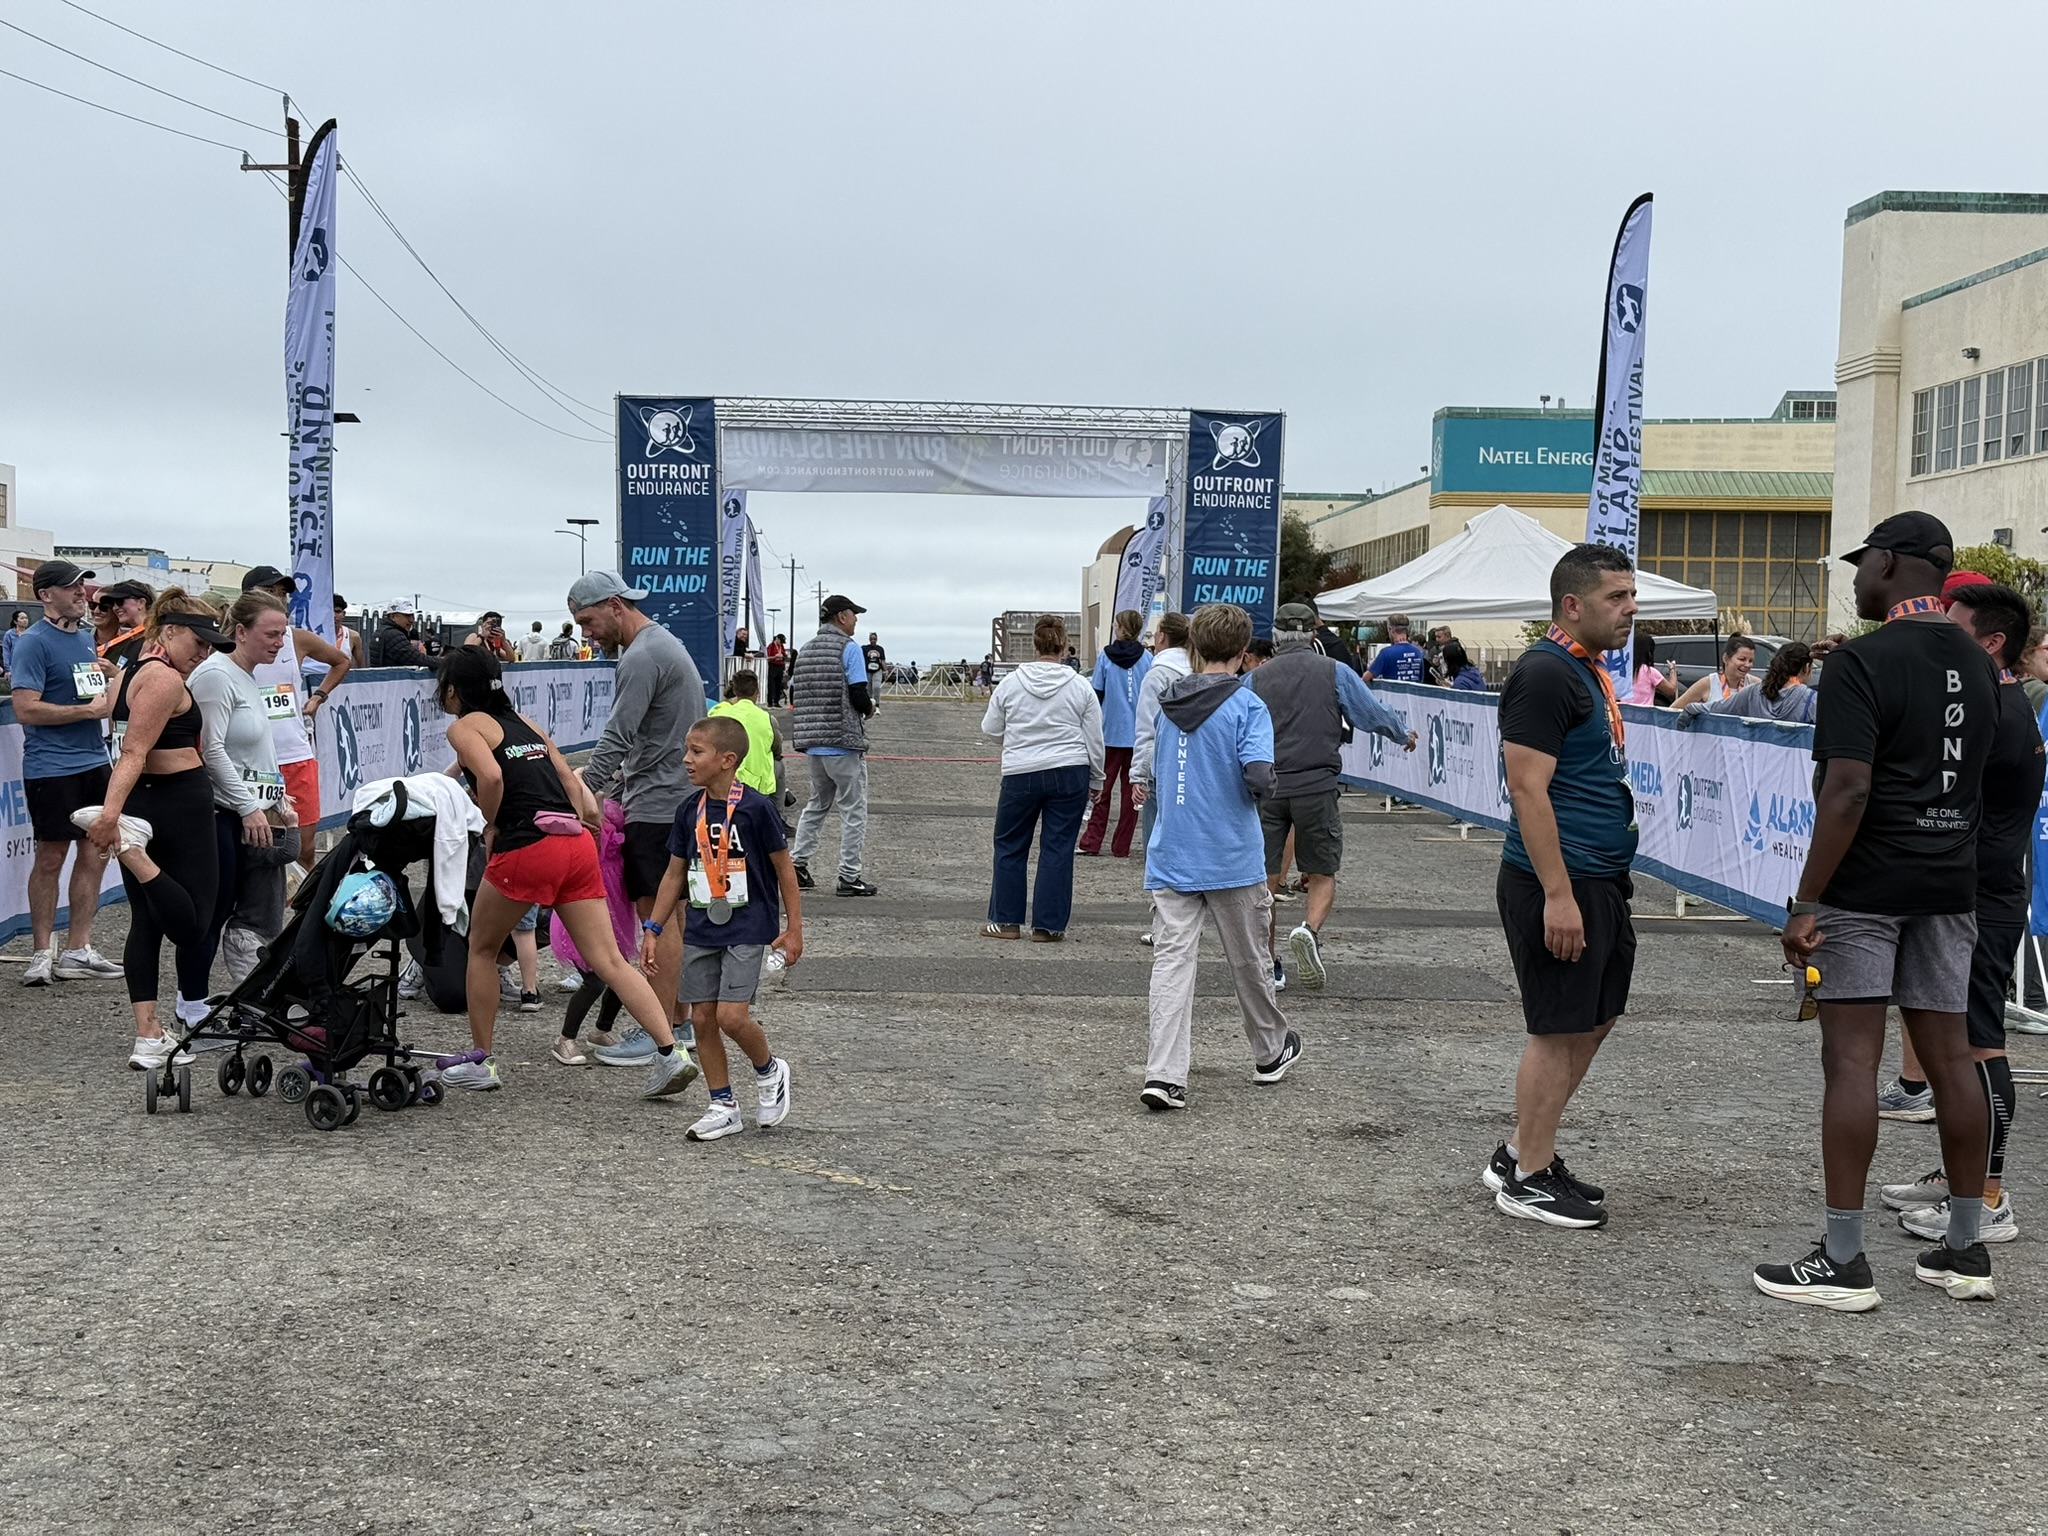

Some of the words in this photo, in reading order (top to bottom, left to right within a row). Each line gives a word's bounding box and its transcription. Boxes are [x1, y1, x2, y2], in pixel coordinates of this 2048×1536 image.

[1628, 356, 1643, 469] FESTIVAL
[1537, 446, 1594, 466] ENERG
[627, 463, 712, 480] OUTFRONT
[627, 481, 711, 496] ENDURANCE
[1193, 475, 1274, 494] OUTFRONT
[1193, 493, 1272, 510] ENDURANCE
[631, 547, 670, 566] RUN
[673, 547, 711, 566] THE
[1191, 556, 1236, 577] RUN
[1237, 558, 1270, 578] THE
[634, 574, 708, 594] ISLAND!
[1193, 583, 1265, 605] ISLAND!
[86, 673, 103, 687] 153
[265, 694, 290, 709] 196
[257, 784, 284, 801] 1035
[1765, 792, 1815, 838] ALAM
[1926, 807, 1939, 817] BE
[1939, 808, 1963, 819] ONE.
[1916, 817, 1934, 828] NOT
[1772, 841, 1803, 862] HEALTH
[1992, 1208, 2011, 1225] HOKA
